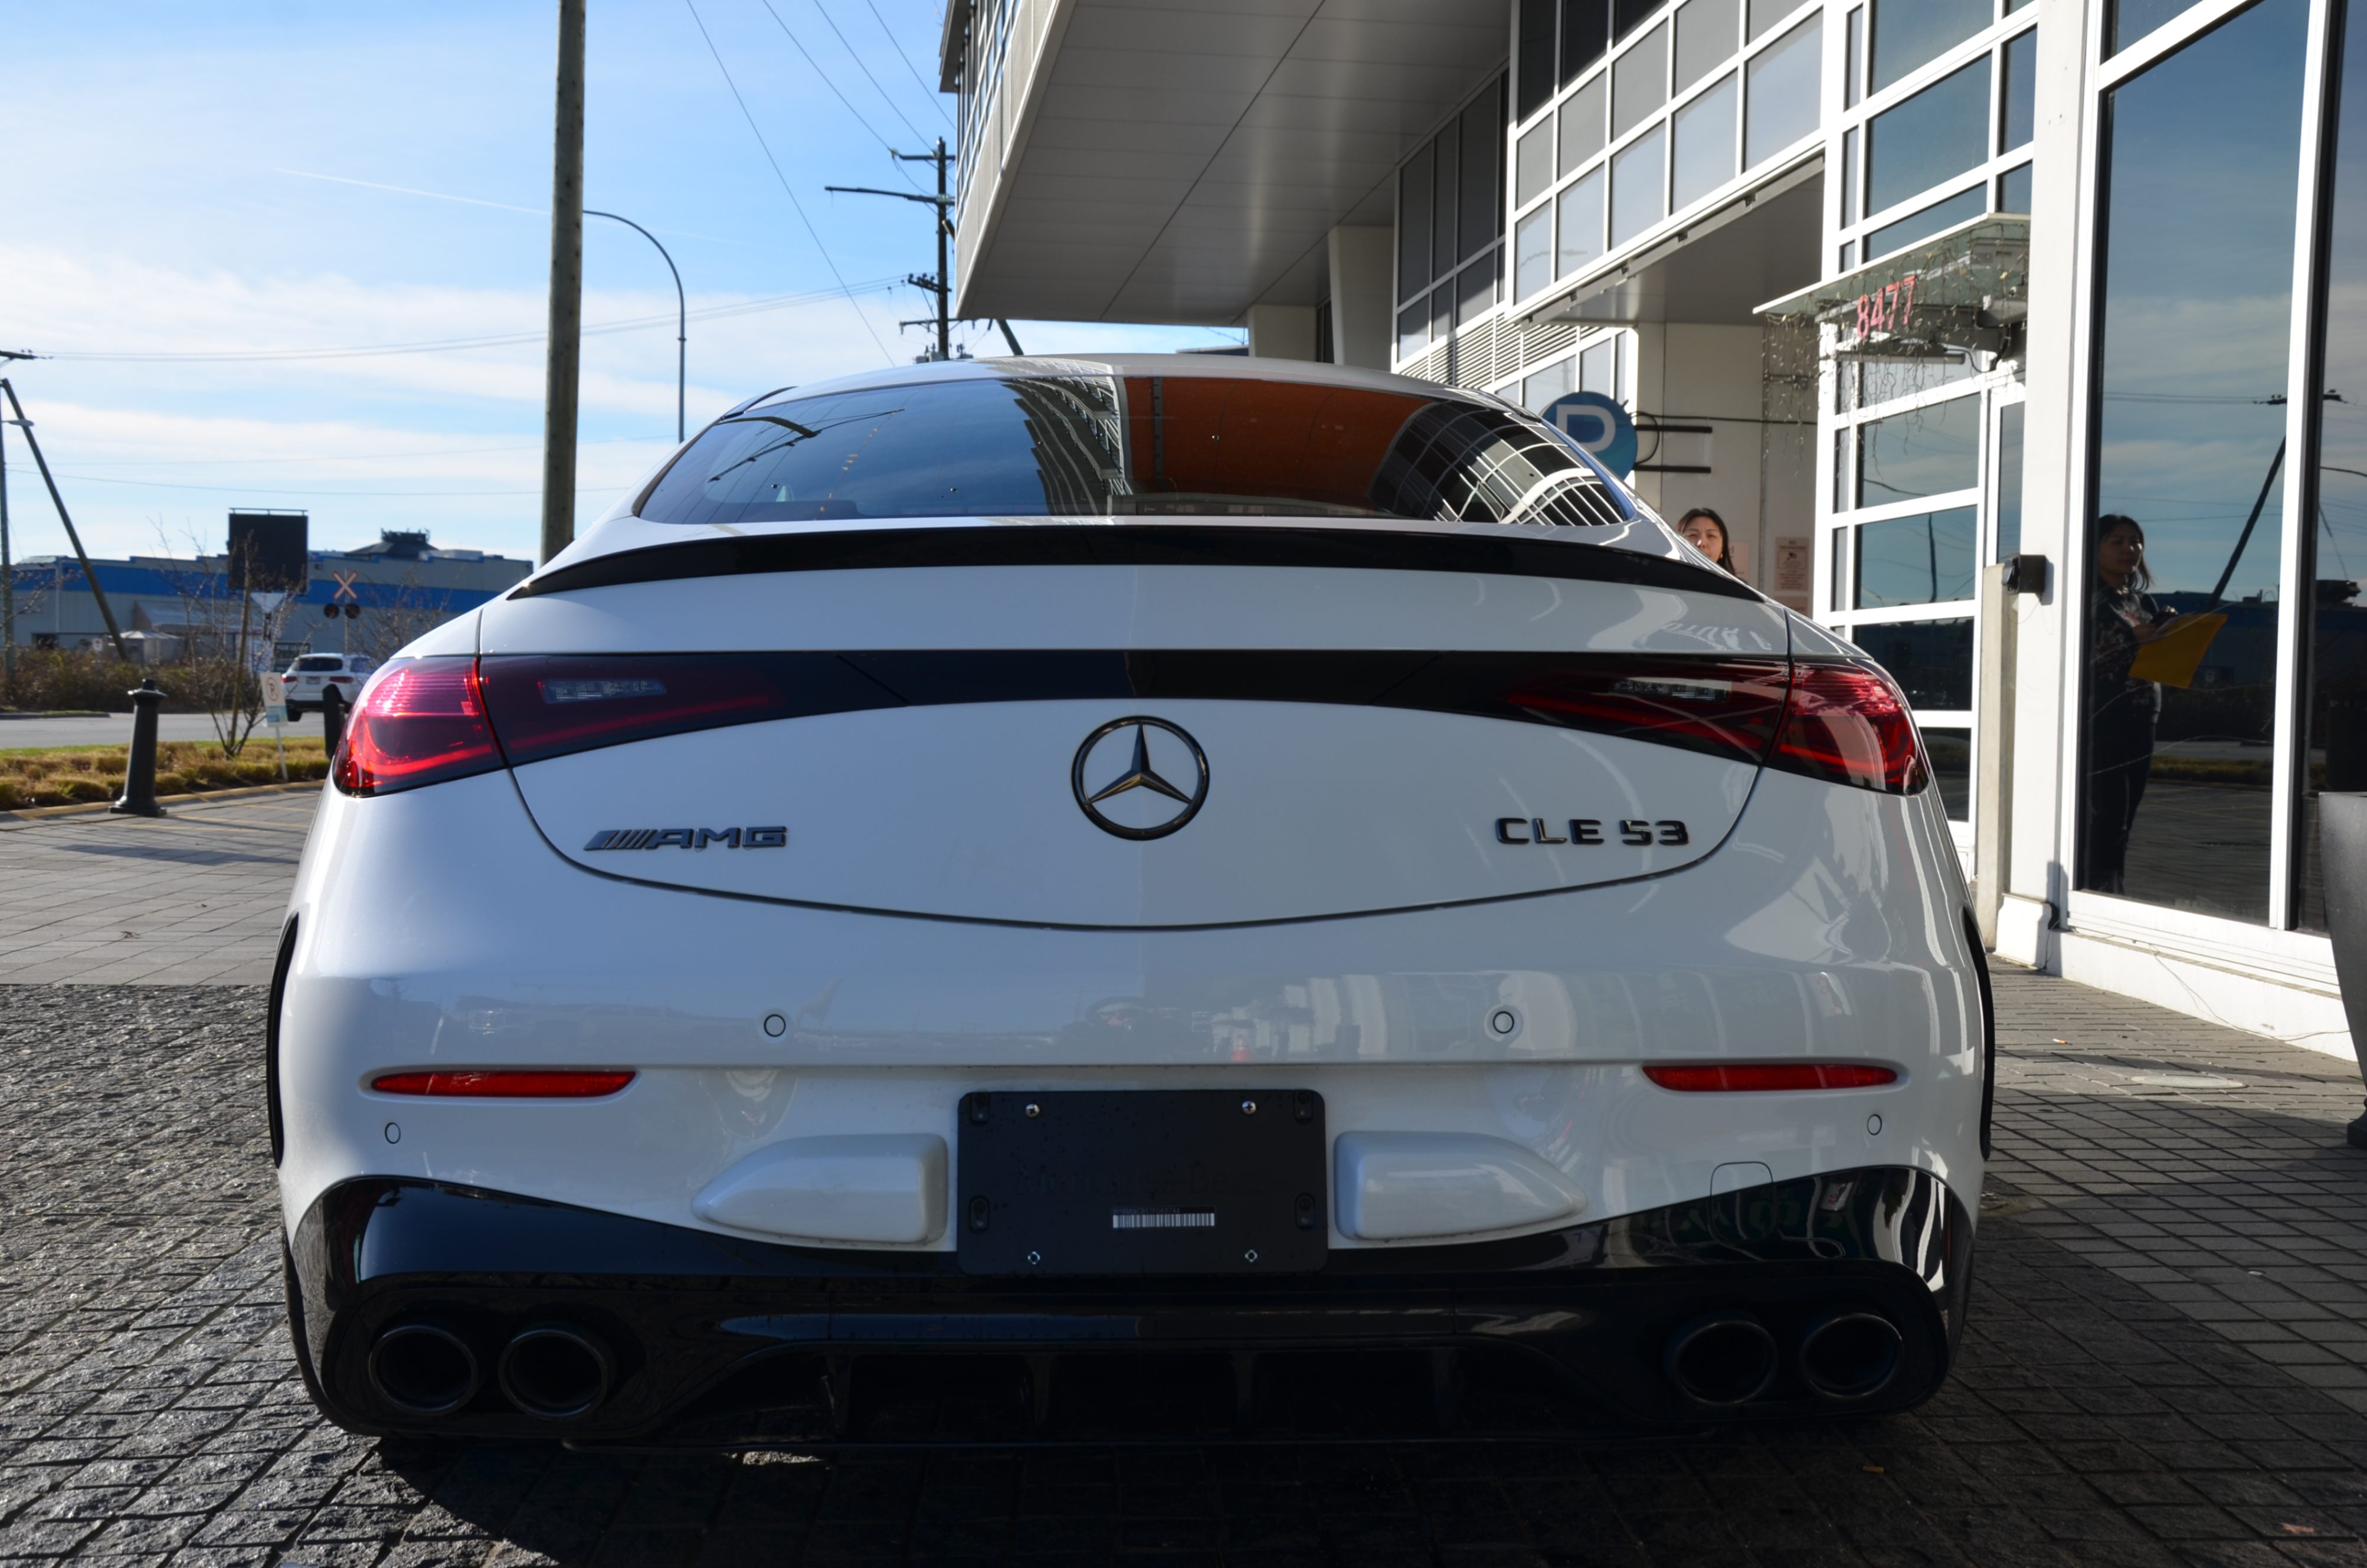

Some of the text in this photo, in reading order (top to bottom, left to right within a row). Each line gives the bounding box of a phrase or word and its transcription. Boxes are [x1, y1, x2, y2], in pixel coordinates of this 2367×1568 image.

[1857, 274, 1917, 340] 8477
[645, 826, 787, 850] AMG
[1495, 817, 1690, 846] CLE 53
